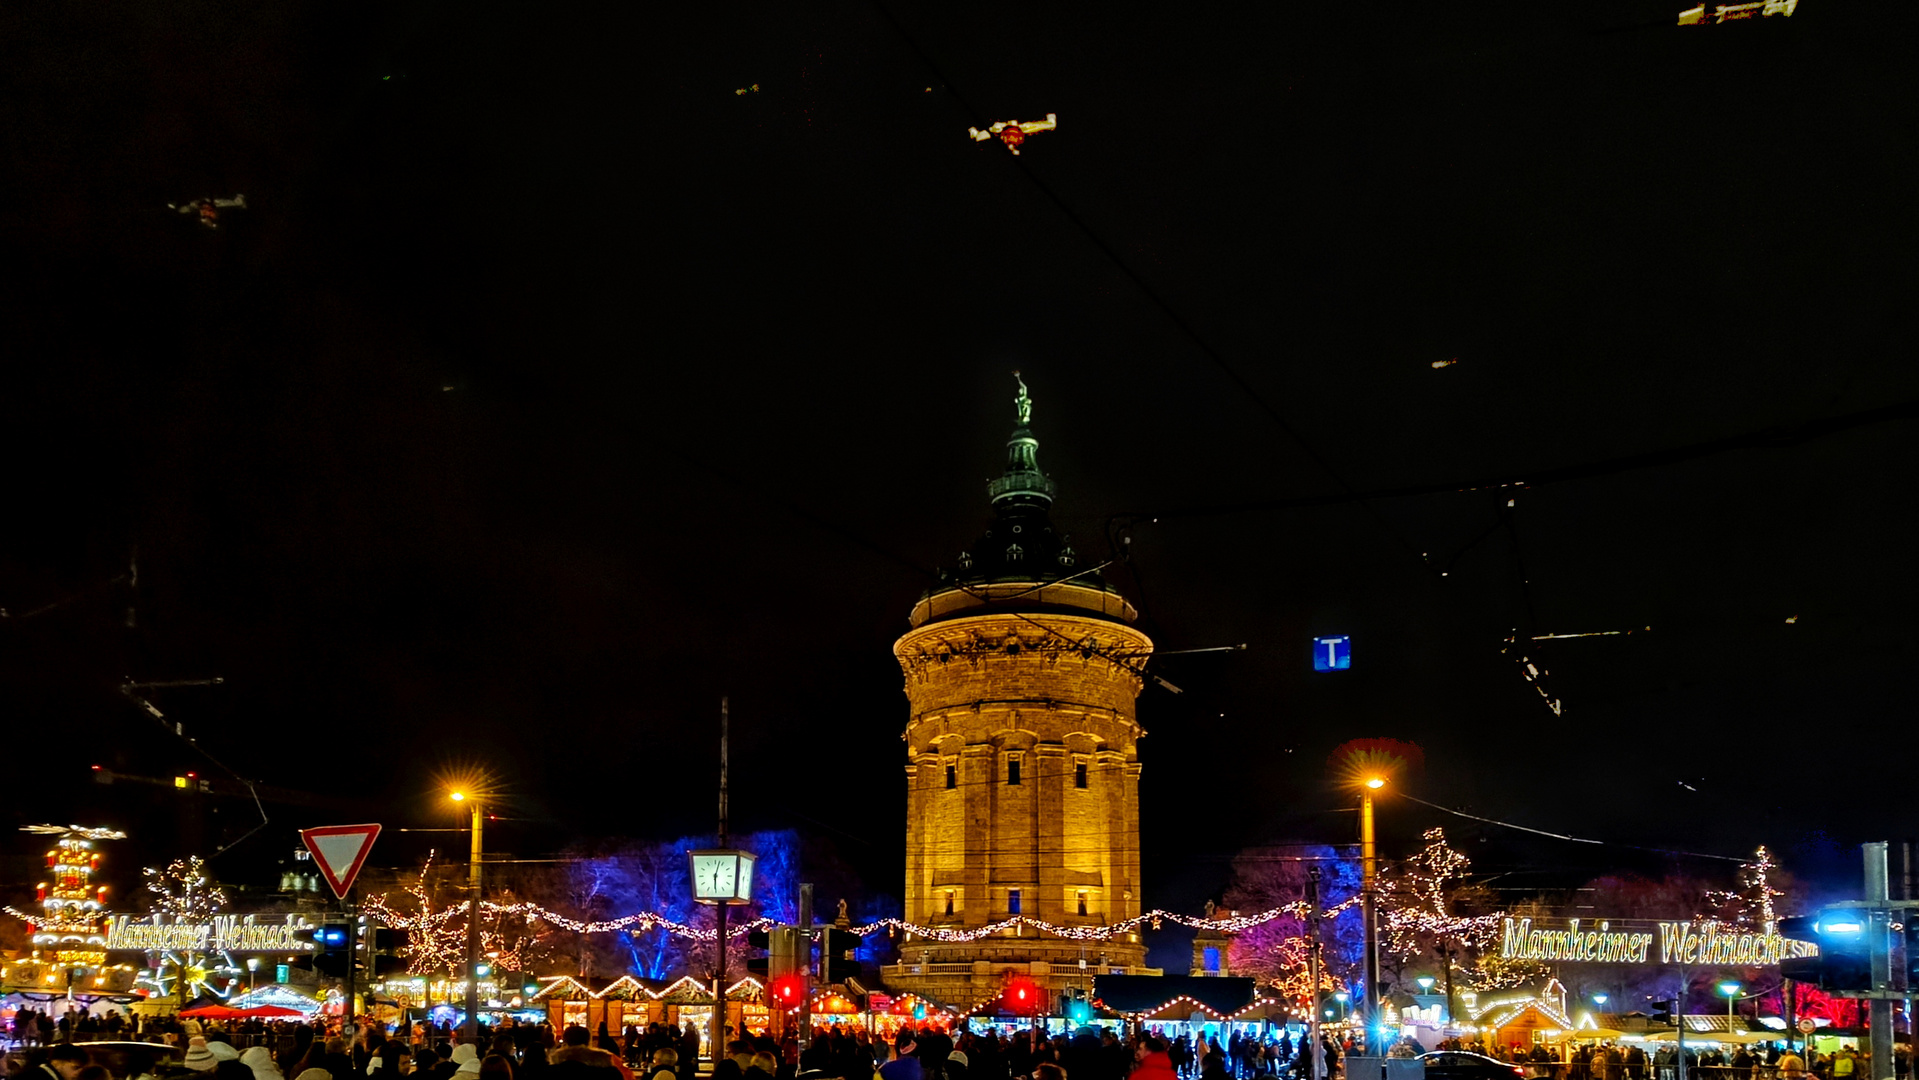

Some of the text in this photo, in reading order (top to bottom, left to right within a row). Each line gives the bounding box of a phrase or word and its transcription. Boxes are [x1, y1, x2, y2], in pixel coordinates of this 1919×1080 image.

[1321, 638, 1342, 667] T
[105, 914, 209, 950] Mannheimer
[1501, 918, 1652, 963] Mannheimer
